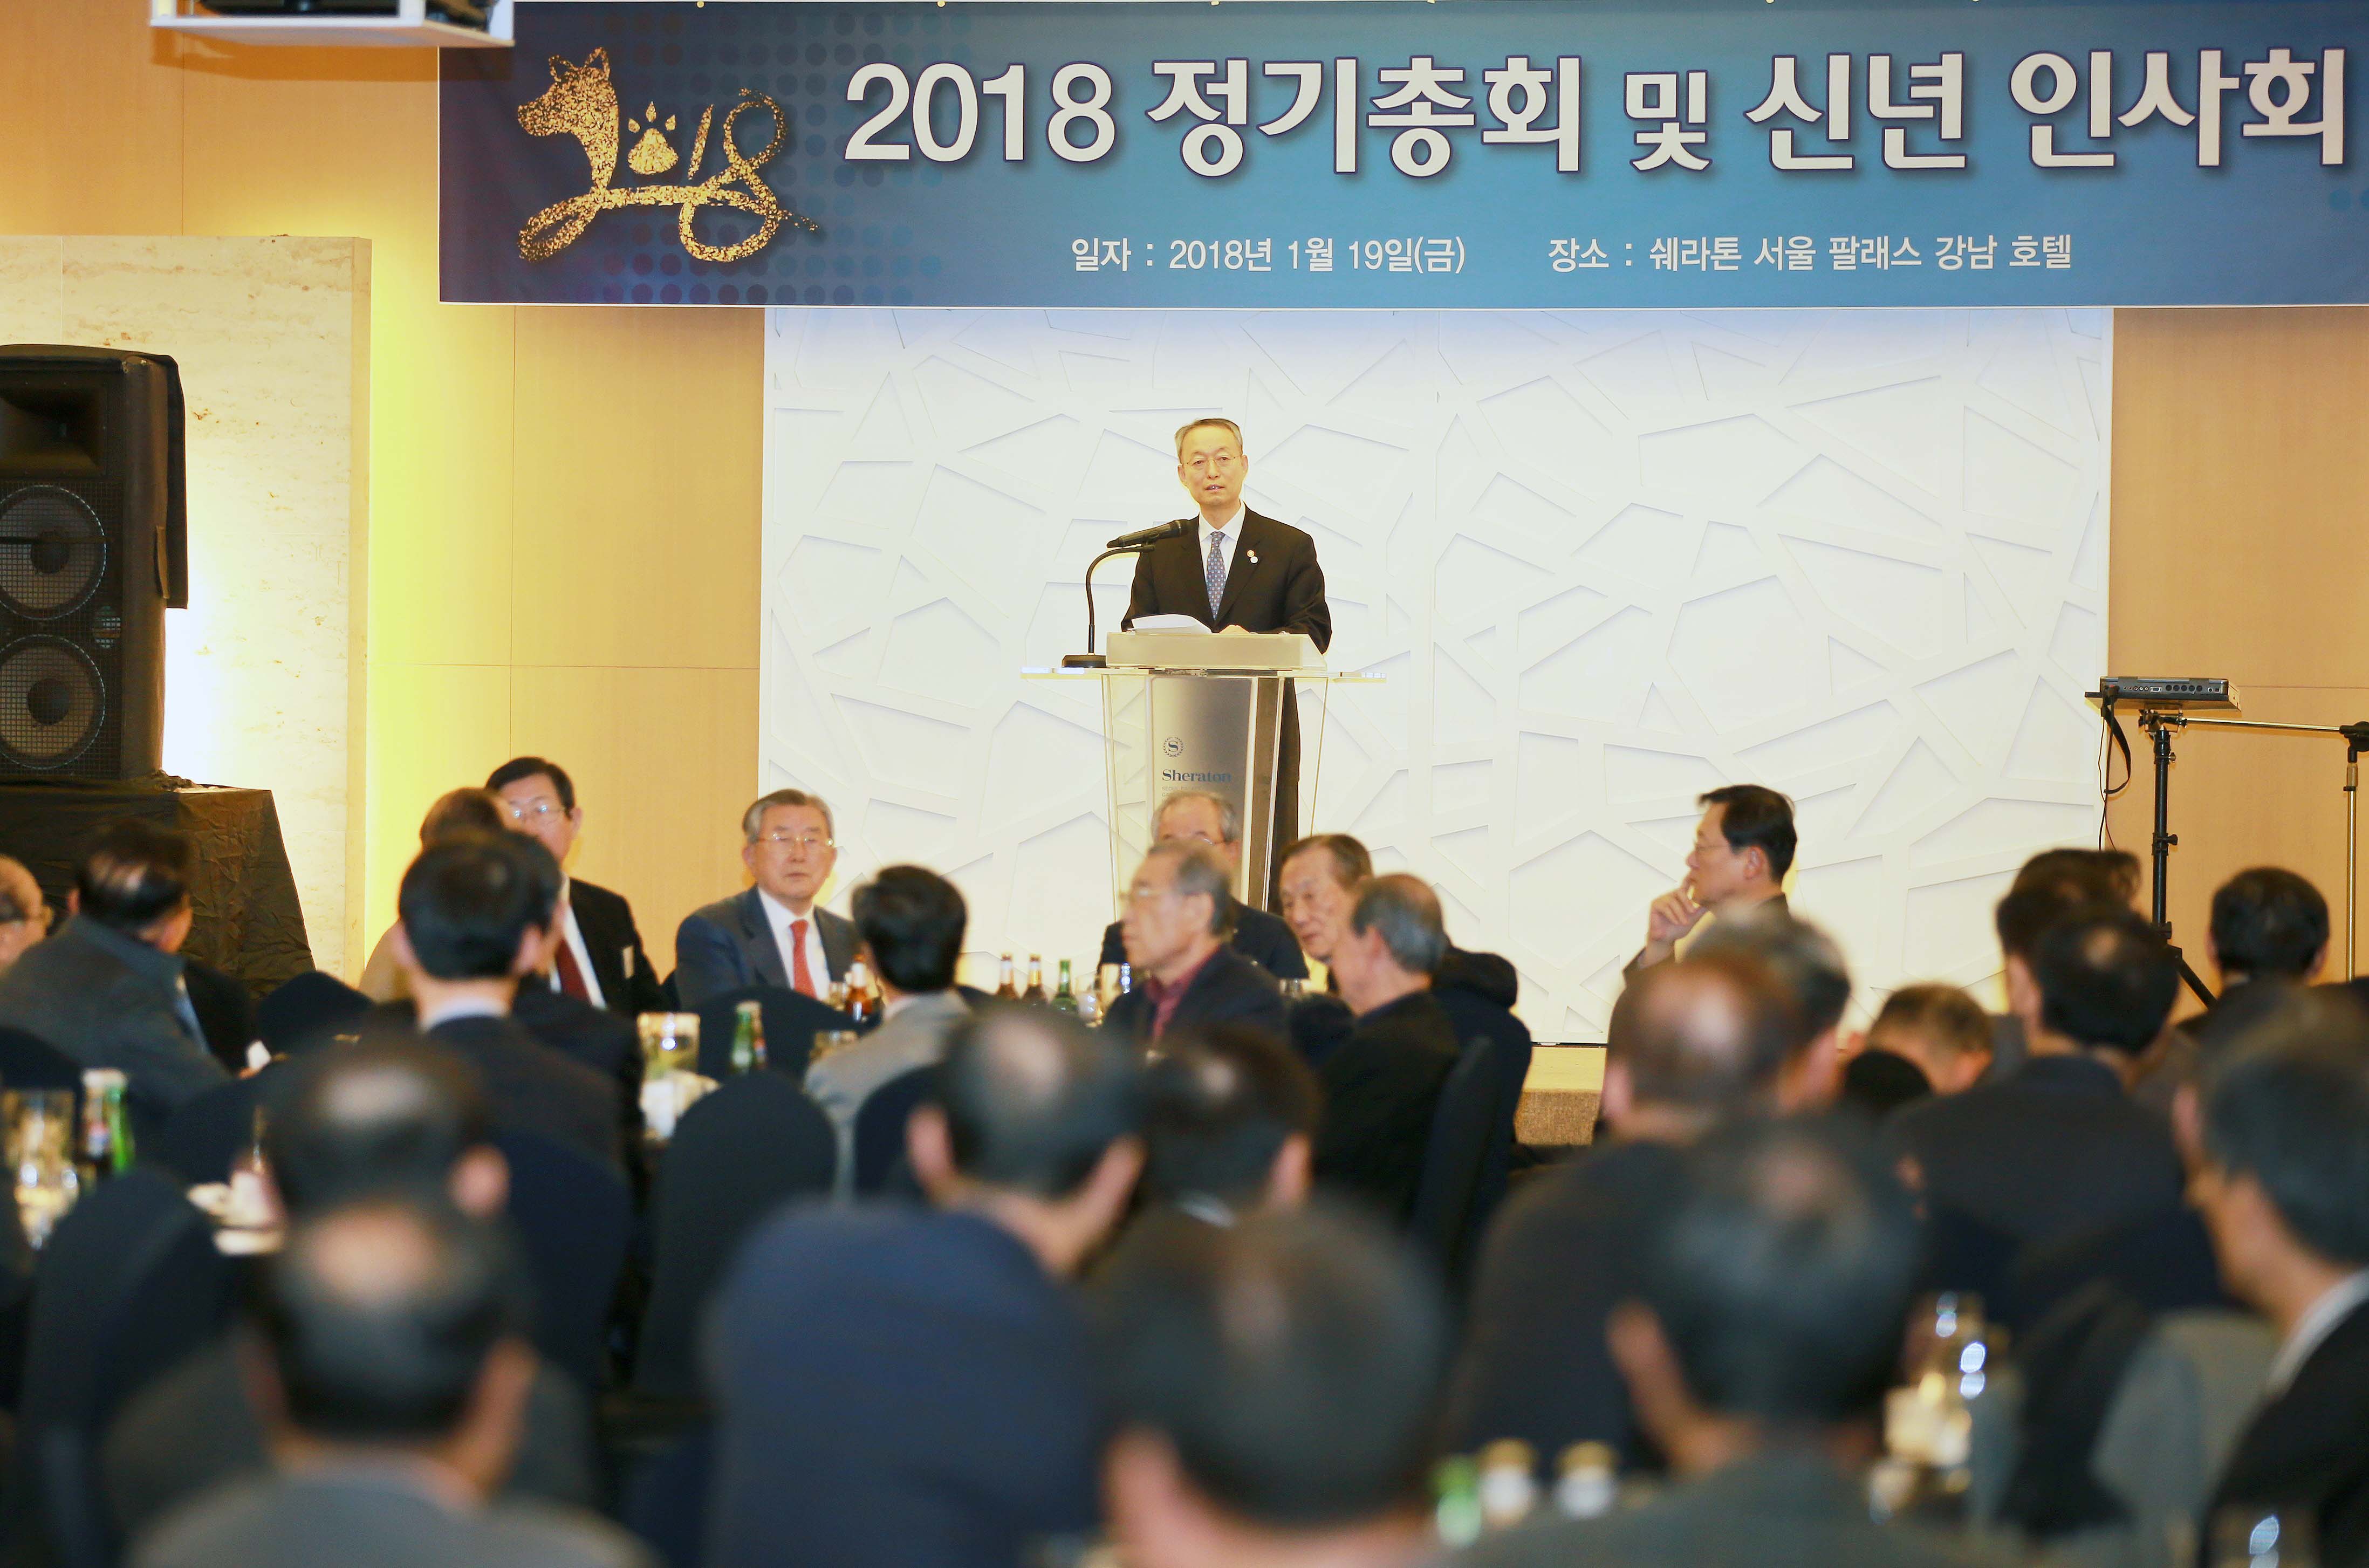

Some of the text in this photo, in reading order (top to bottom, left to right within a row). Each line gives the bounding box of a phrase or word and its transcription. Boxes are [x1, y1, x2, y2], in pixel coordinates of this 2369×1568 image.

[843, 48, 2345, 178] 2018 정기총회 및 신년 인사회
[1071, 237, 1132, 272] 일자
[1169, 237, 1272, 272] 2018년
[1288, 237, 1333, 272] 1월
[1348, 236, 1466, 274] 19일(금)
[1548, 237, 1610, 272] 장소
[1649, 236, 1742, 272] 쉐라톤
[1753, 235, 1817, 271] 서울
[1828, 235, 1922, 271] 팔래스
[1935, 234, 1998, 271] 강남
[2009, 234, 2071, 269] 호텔
[1162, 769, 1232, 782] Sheraton
